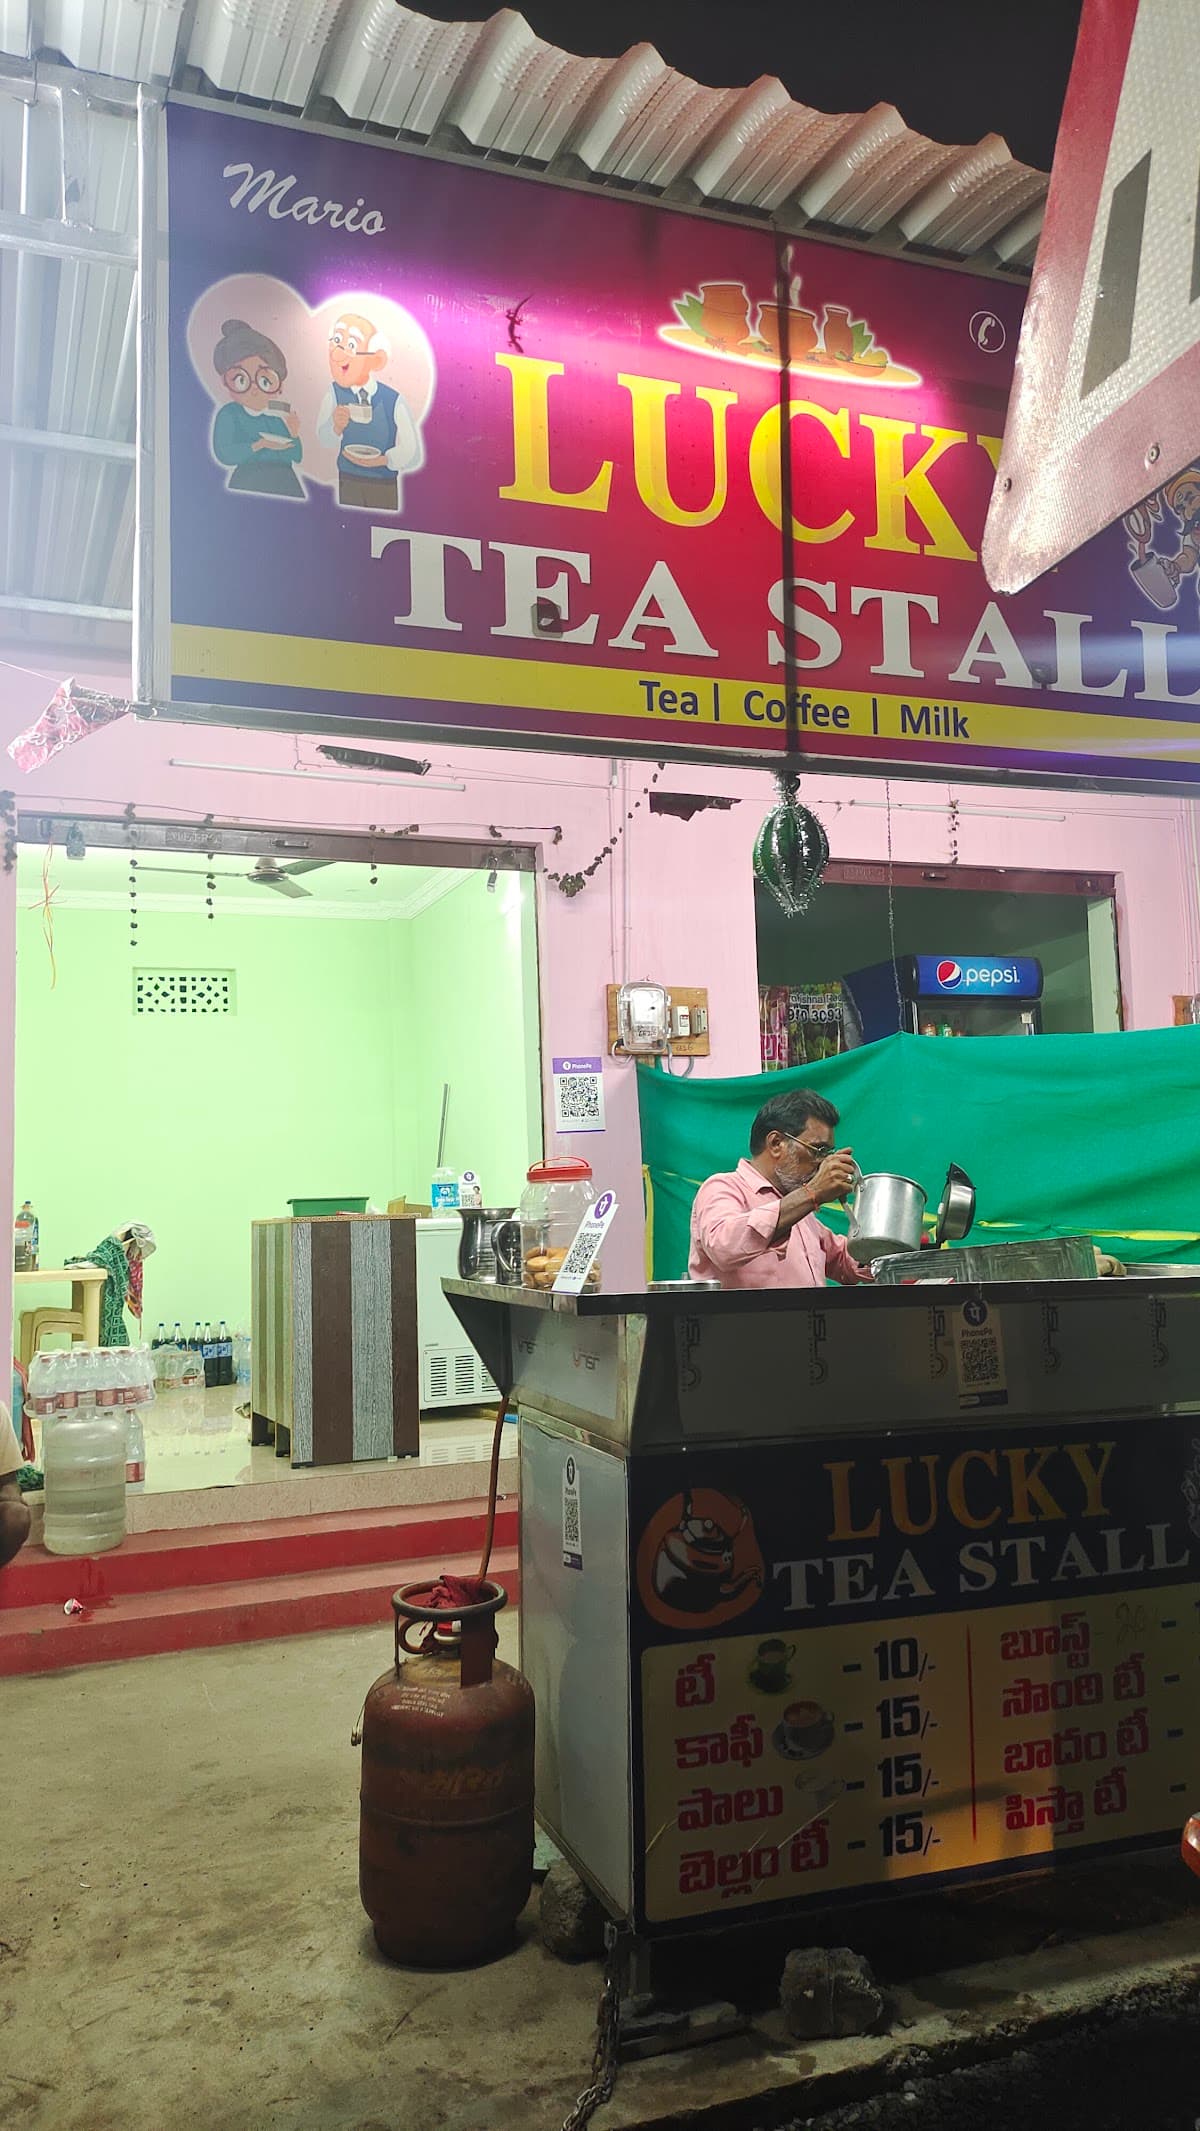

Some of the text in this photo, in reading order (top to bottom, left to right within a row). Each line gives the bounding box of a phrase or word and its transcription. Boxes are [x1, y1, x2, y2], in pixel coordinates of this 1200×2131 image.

[222, 162, 386, 236] Mario
[495, 352, 1003, 563] LUCK
[371, 526, 1200, 706] TEA STALL
[743, 690, 850, 729] Coffee
[901, 704, 970, 739] Milk
[965, 965, 1019, 988] pepsi
[823, 1441, 1117, 1542] LUCKY
[773, 1522, 1190, 1613] TEA STALL
[873, 1637, 936, 1682] 10/-
[875, 1695, 938, 1741] 15/-
[677, 1785, 784, 1832] పాలు
[877, 1753, 939, 1797] 15/-
[879, 1811, 941, 1857] 15/-
